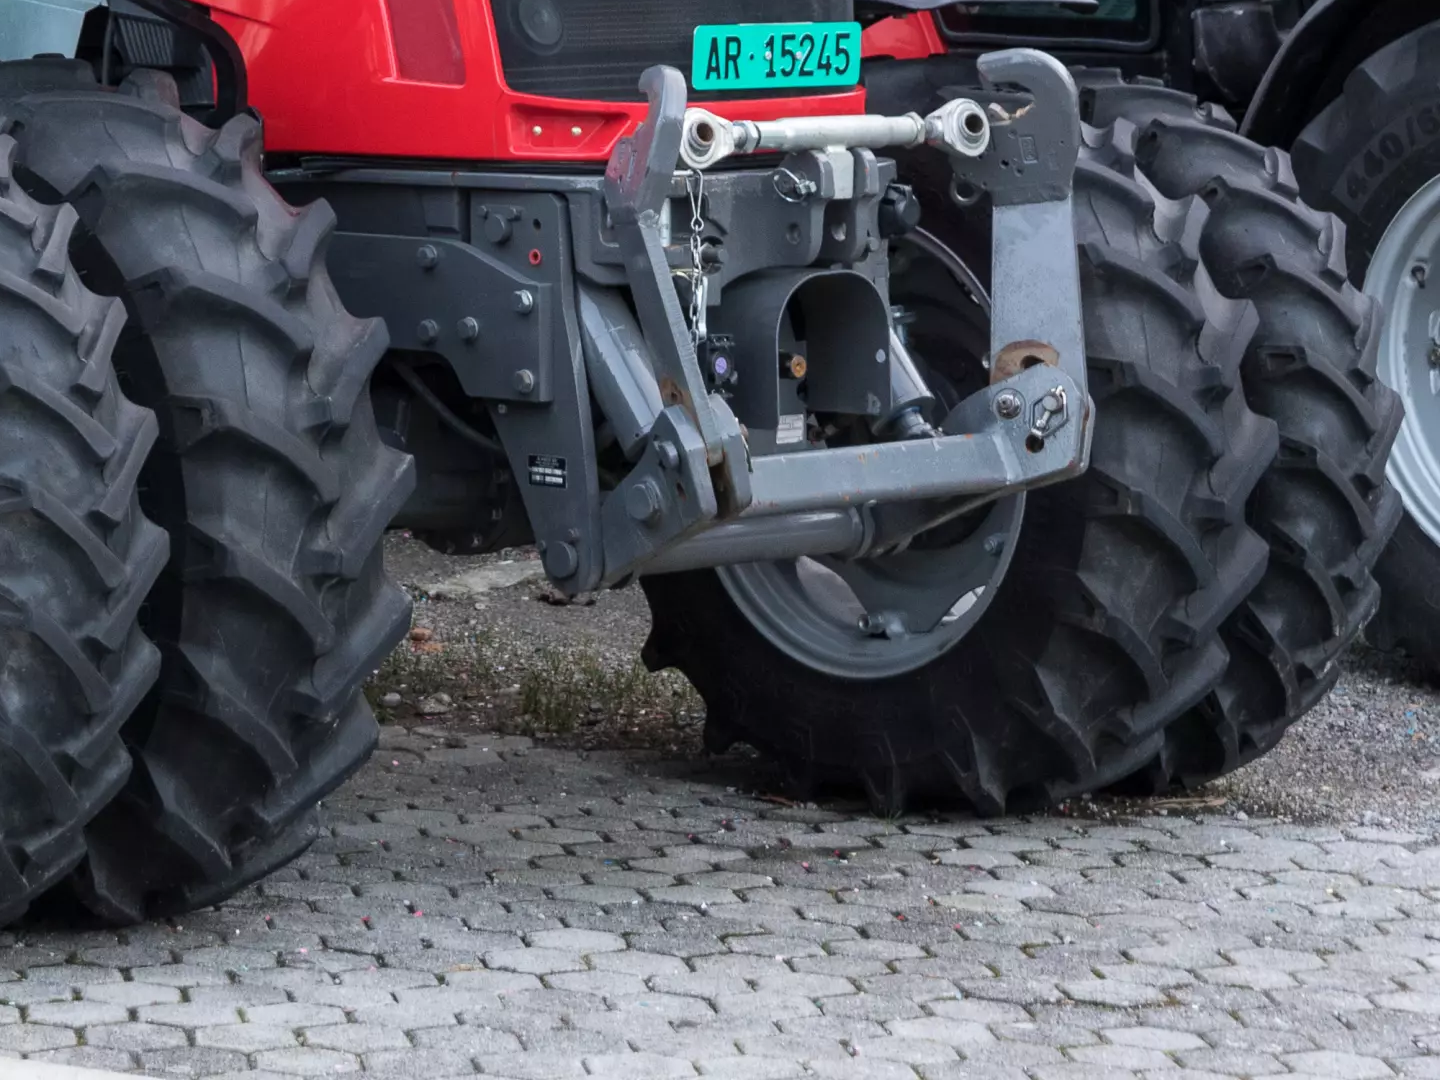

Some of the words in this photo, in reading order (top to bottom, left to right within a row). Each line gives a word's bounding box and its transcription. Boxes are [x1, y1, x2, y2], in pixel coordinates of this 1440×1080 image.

[705, 35, 743, 81] AR
[764, 31, 851, 79] 15245
[1345, 102, 1440, 201] 440/6
